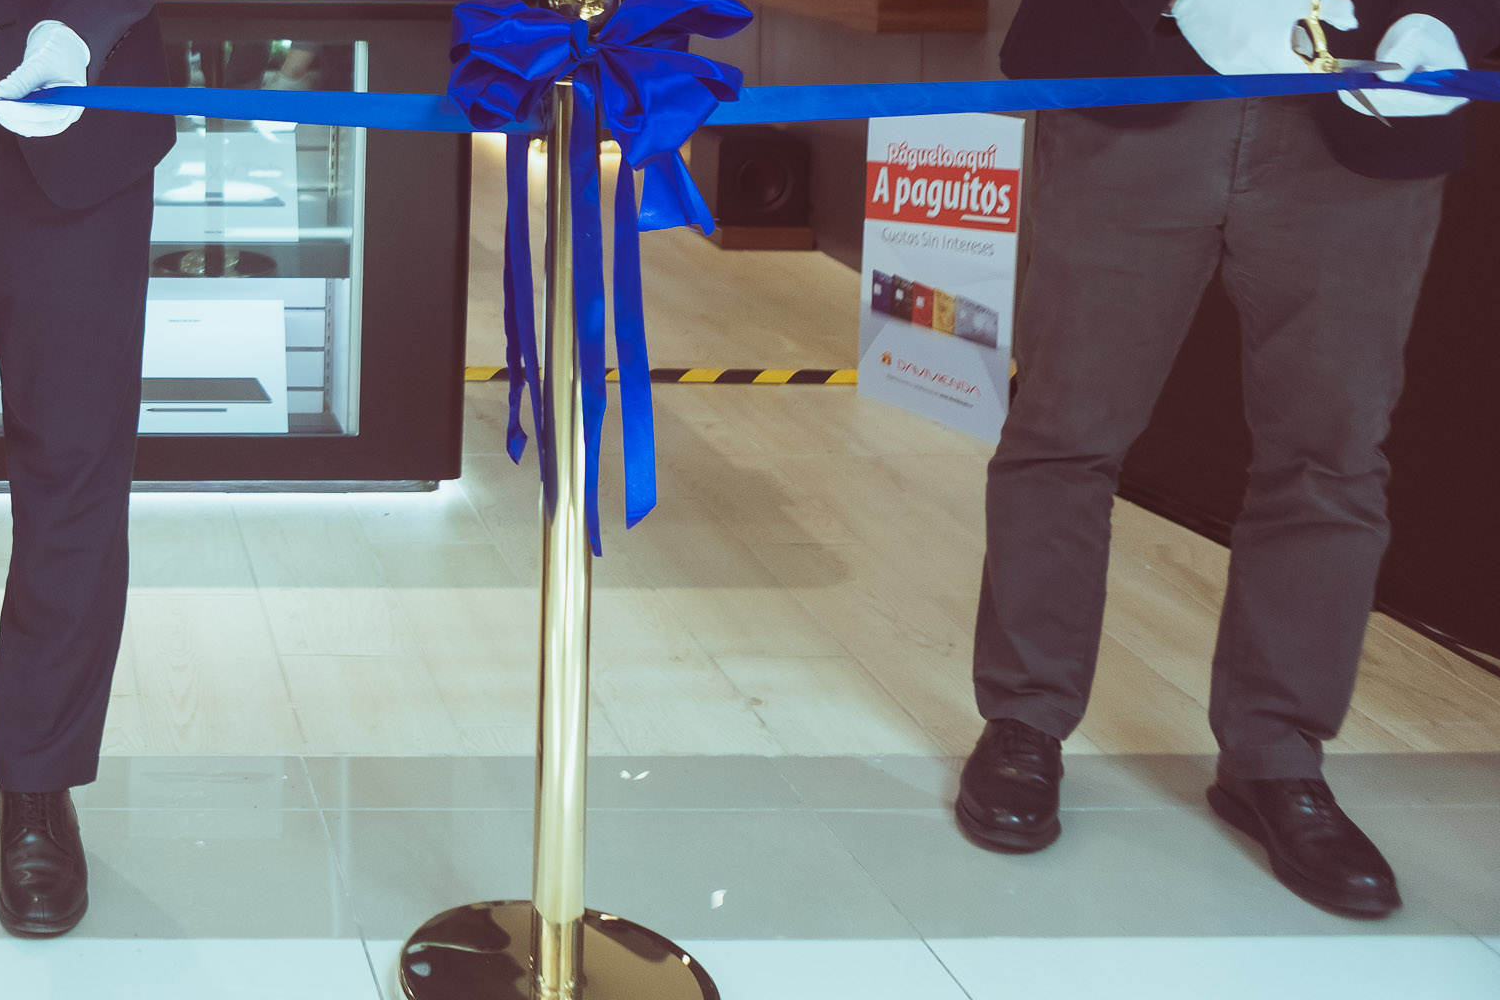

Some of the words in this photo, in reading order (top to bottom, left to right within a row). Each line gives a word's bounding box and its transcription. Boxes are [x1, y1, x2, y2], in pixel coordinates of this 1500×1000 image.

[872, 166, 890, 204] A
[893, 171, 1012, 219] paguitos
[941, 235, 995, 257] Intereses
